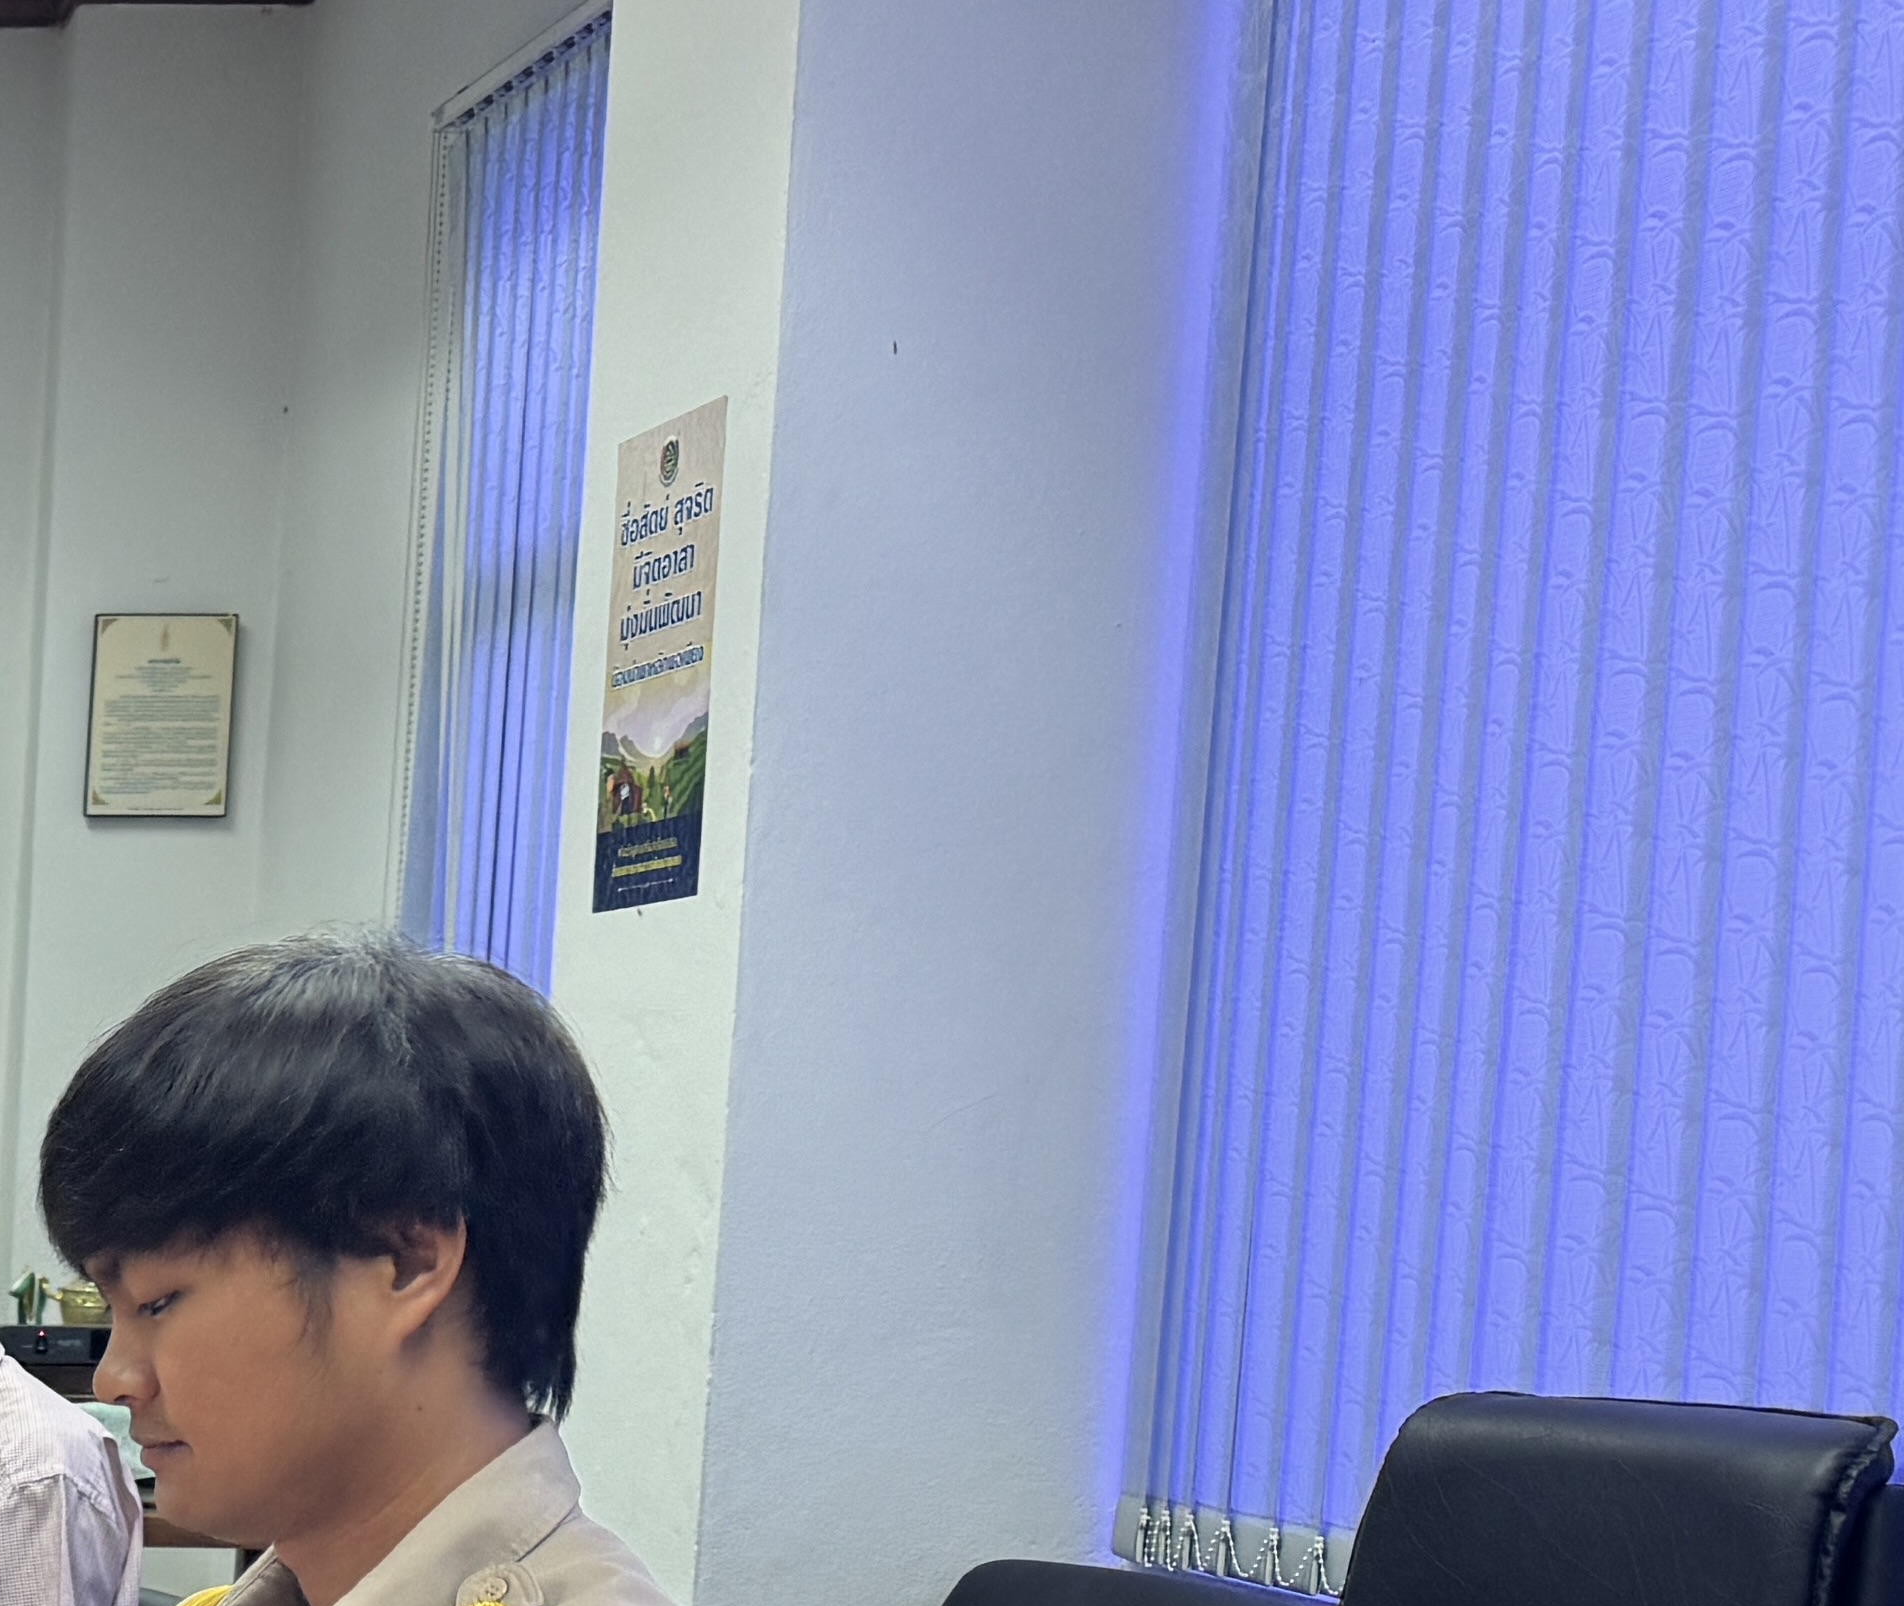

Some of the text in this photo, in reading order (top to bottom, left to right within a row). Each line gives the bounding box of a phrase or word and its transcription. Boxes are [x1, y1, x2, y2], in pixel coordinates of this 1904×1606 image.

[673, 481, 714, 536] สุจริต
[632, 544, 695, 590] มีจิตอาสา
